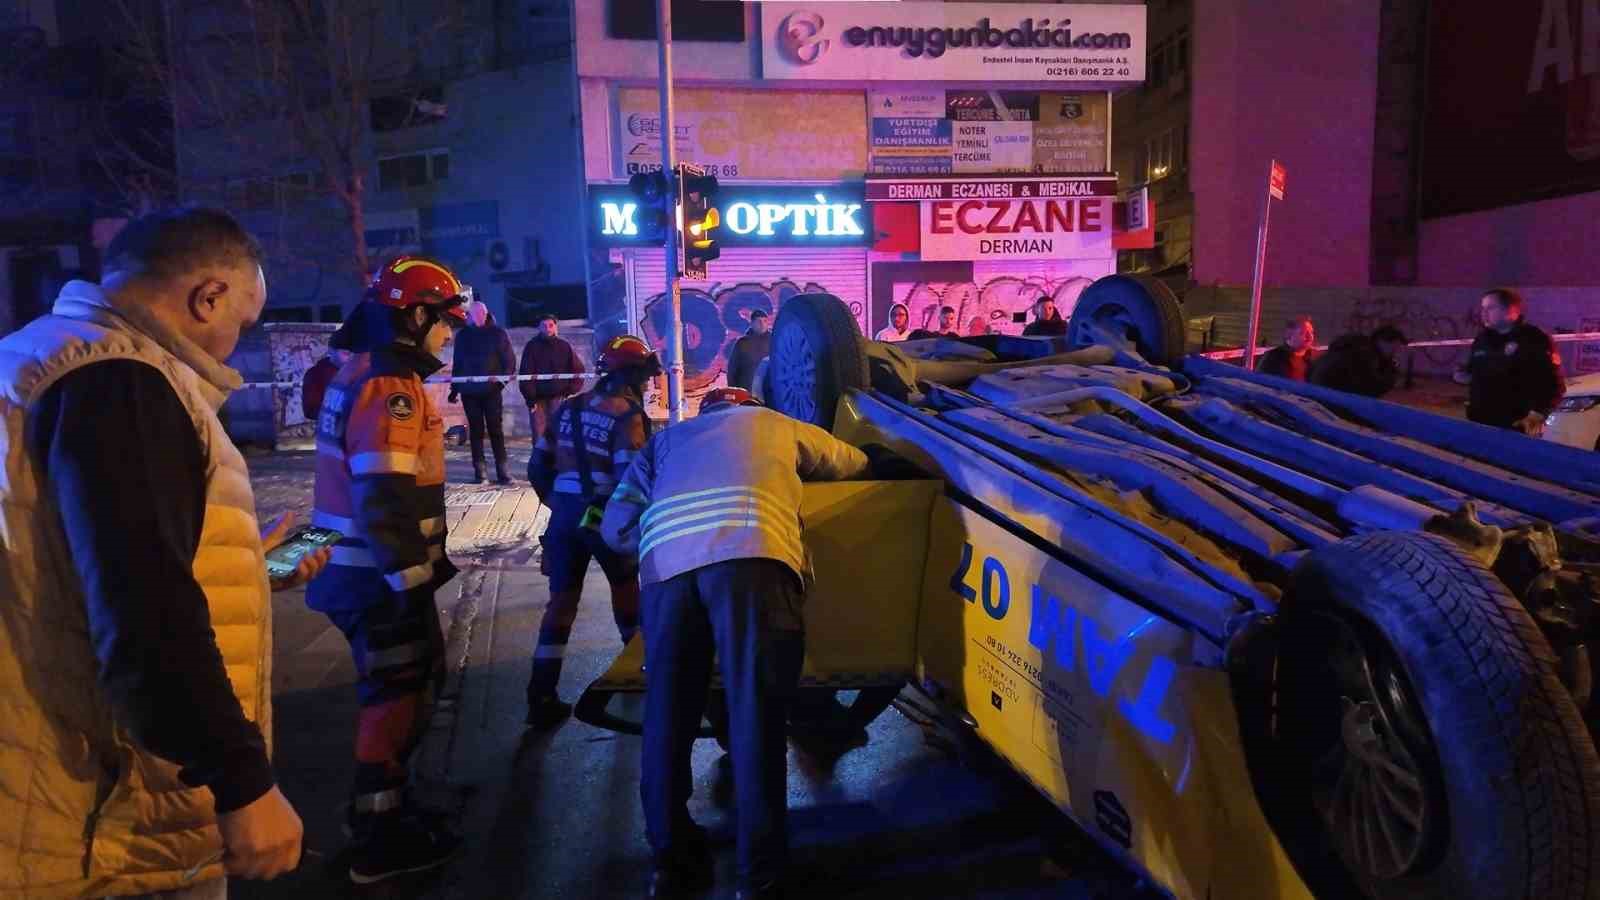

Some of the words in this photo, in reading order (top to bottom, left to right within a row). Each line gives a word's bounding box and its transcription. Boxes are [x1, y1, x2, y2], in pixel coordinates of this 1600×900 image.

[1102, 68, 1115, 76] 22
[1117, 68, 1130, 76] 40
[958, 126, 986, 135] NOTER
[875, 136, 950, 147] DANIŞMANLIK
[954, 151, 991, 162] TERCÜME
[722, 164, 738, 176] 68
[889, 184, 942, 198] DERMAN
[951, 183, 1013, 198] ECZANESİ
[1021, 185, 1031, 197] &
[1039, 181, 1095, 196] MEDİKAL
[931, 200, 1102, 234] ECZANE
[980, 238, 1053, 254] DERMAN
[950, 541, 1011, 621] 07
[1028, 583, 1178, 744] TAM
